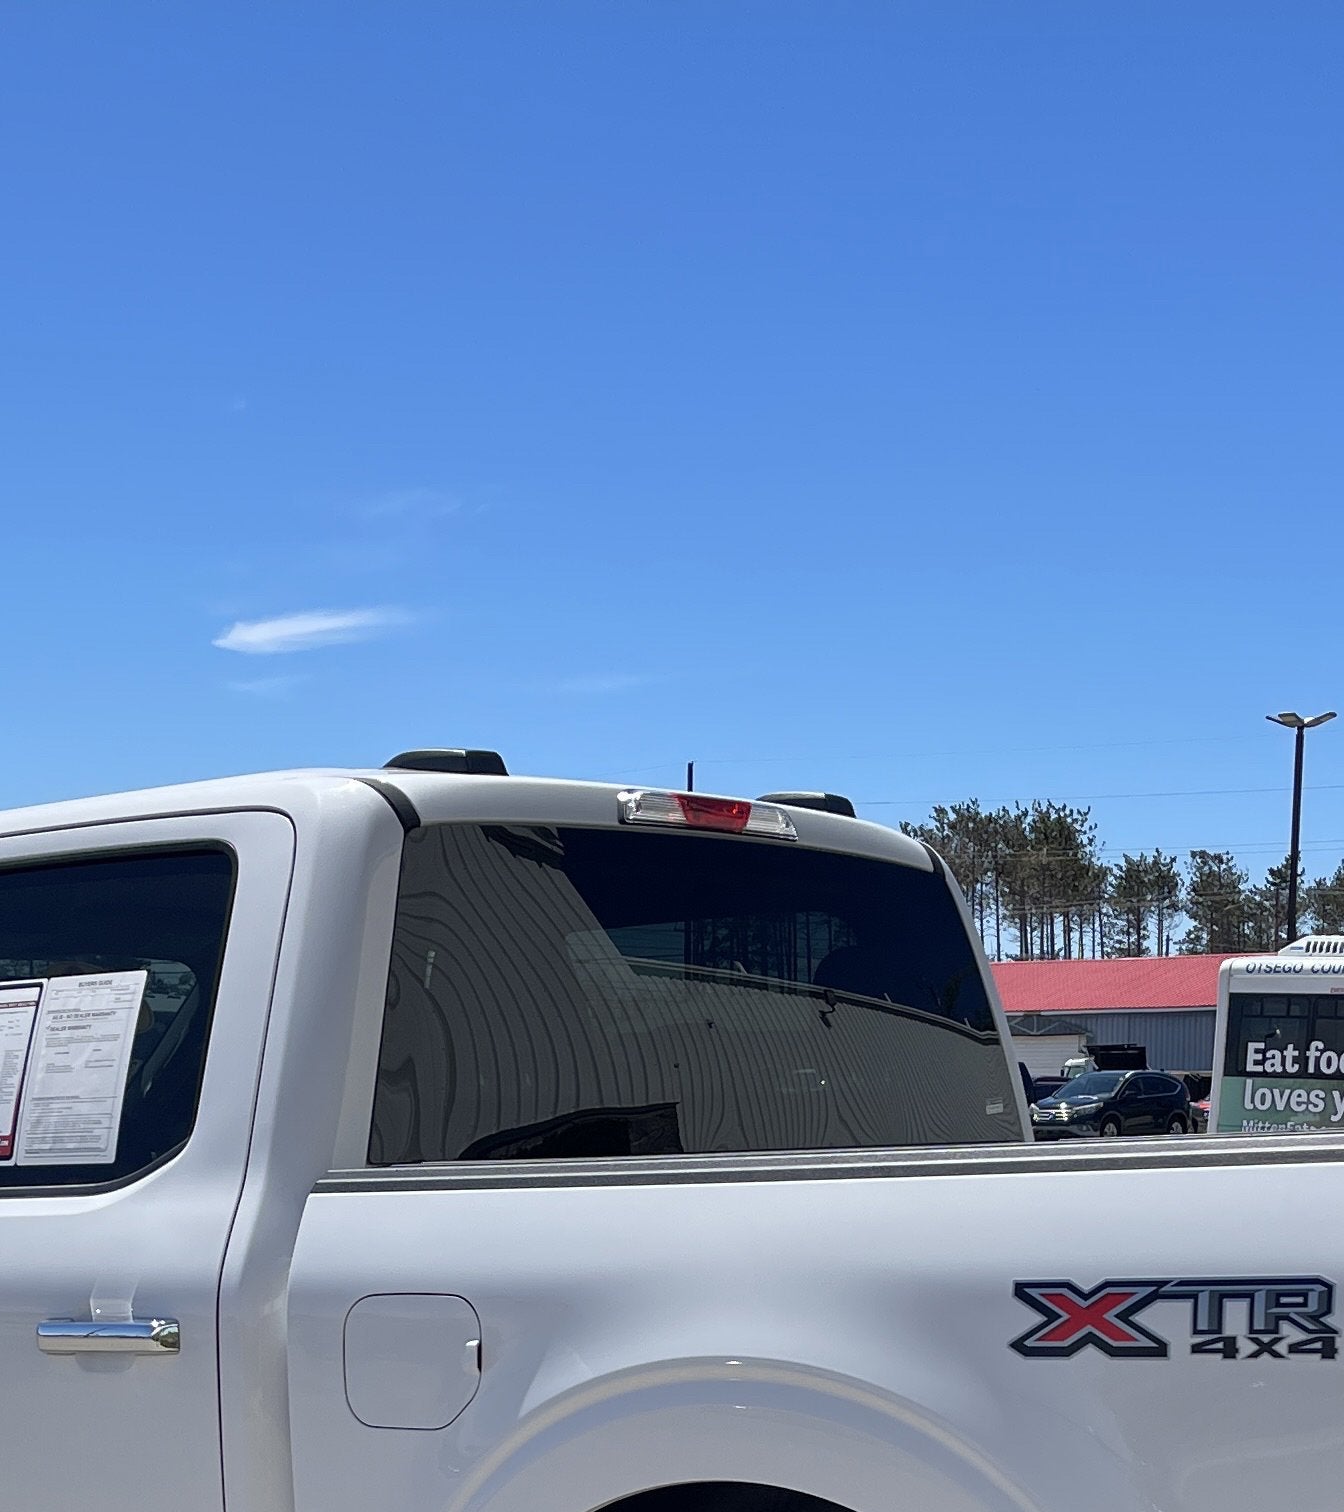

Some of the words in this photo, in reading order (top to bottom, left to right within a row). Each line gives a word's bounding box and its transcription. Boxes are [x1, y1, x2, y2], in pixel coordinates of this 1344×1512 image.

[1245, 1041, 1300, 1074] Eat
[1243, 1079, 1326, 1113] loves
[1007, 1274, 1342, 1360] XTR
